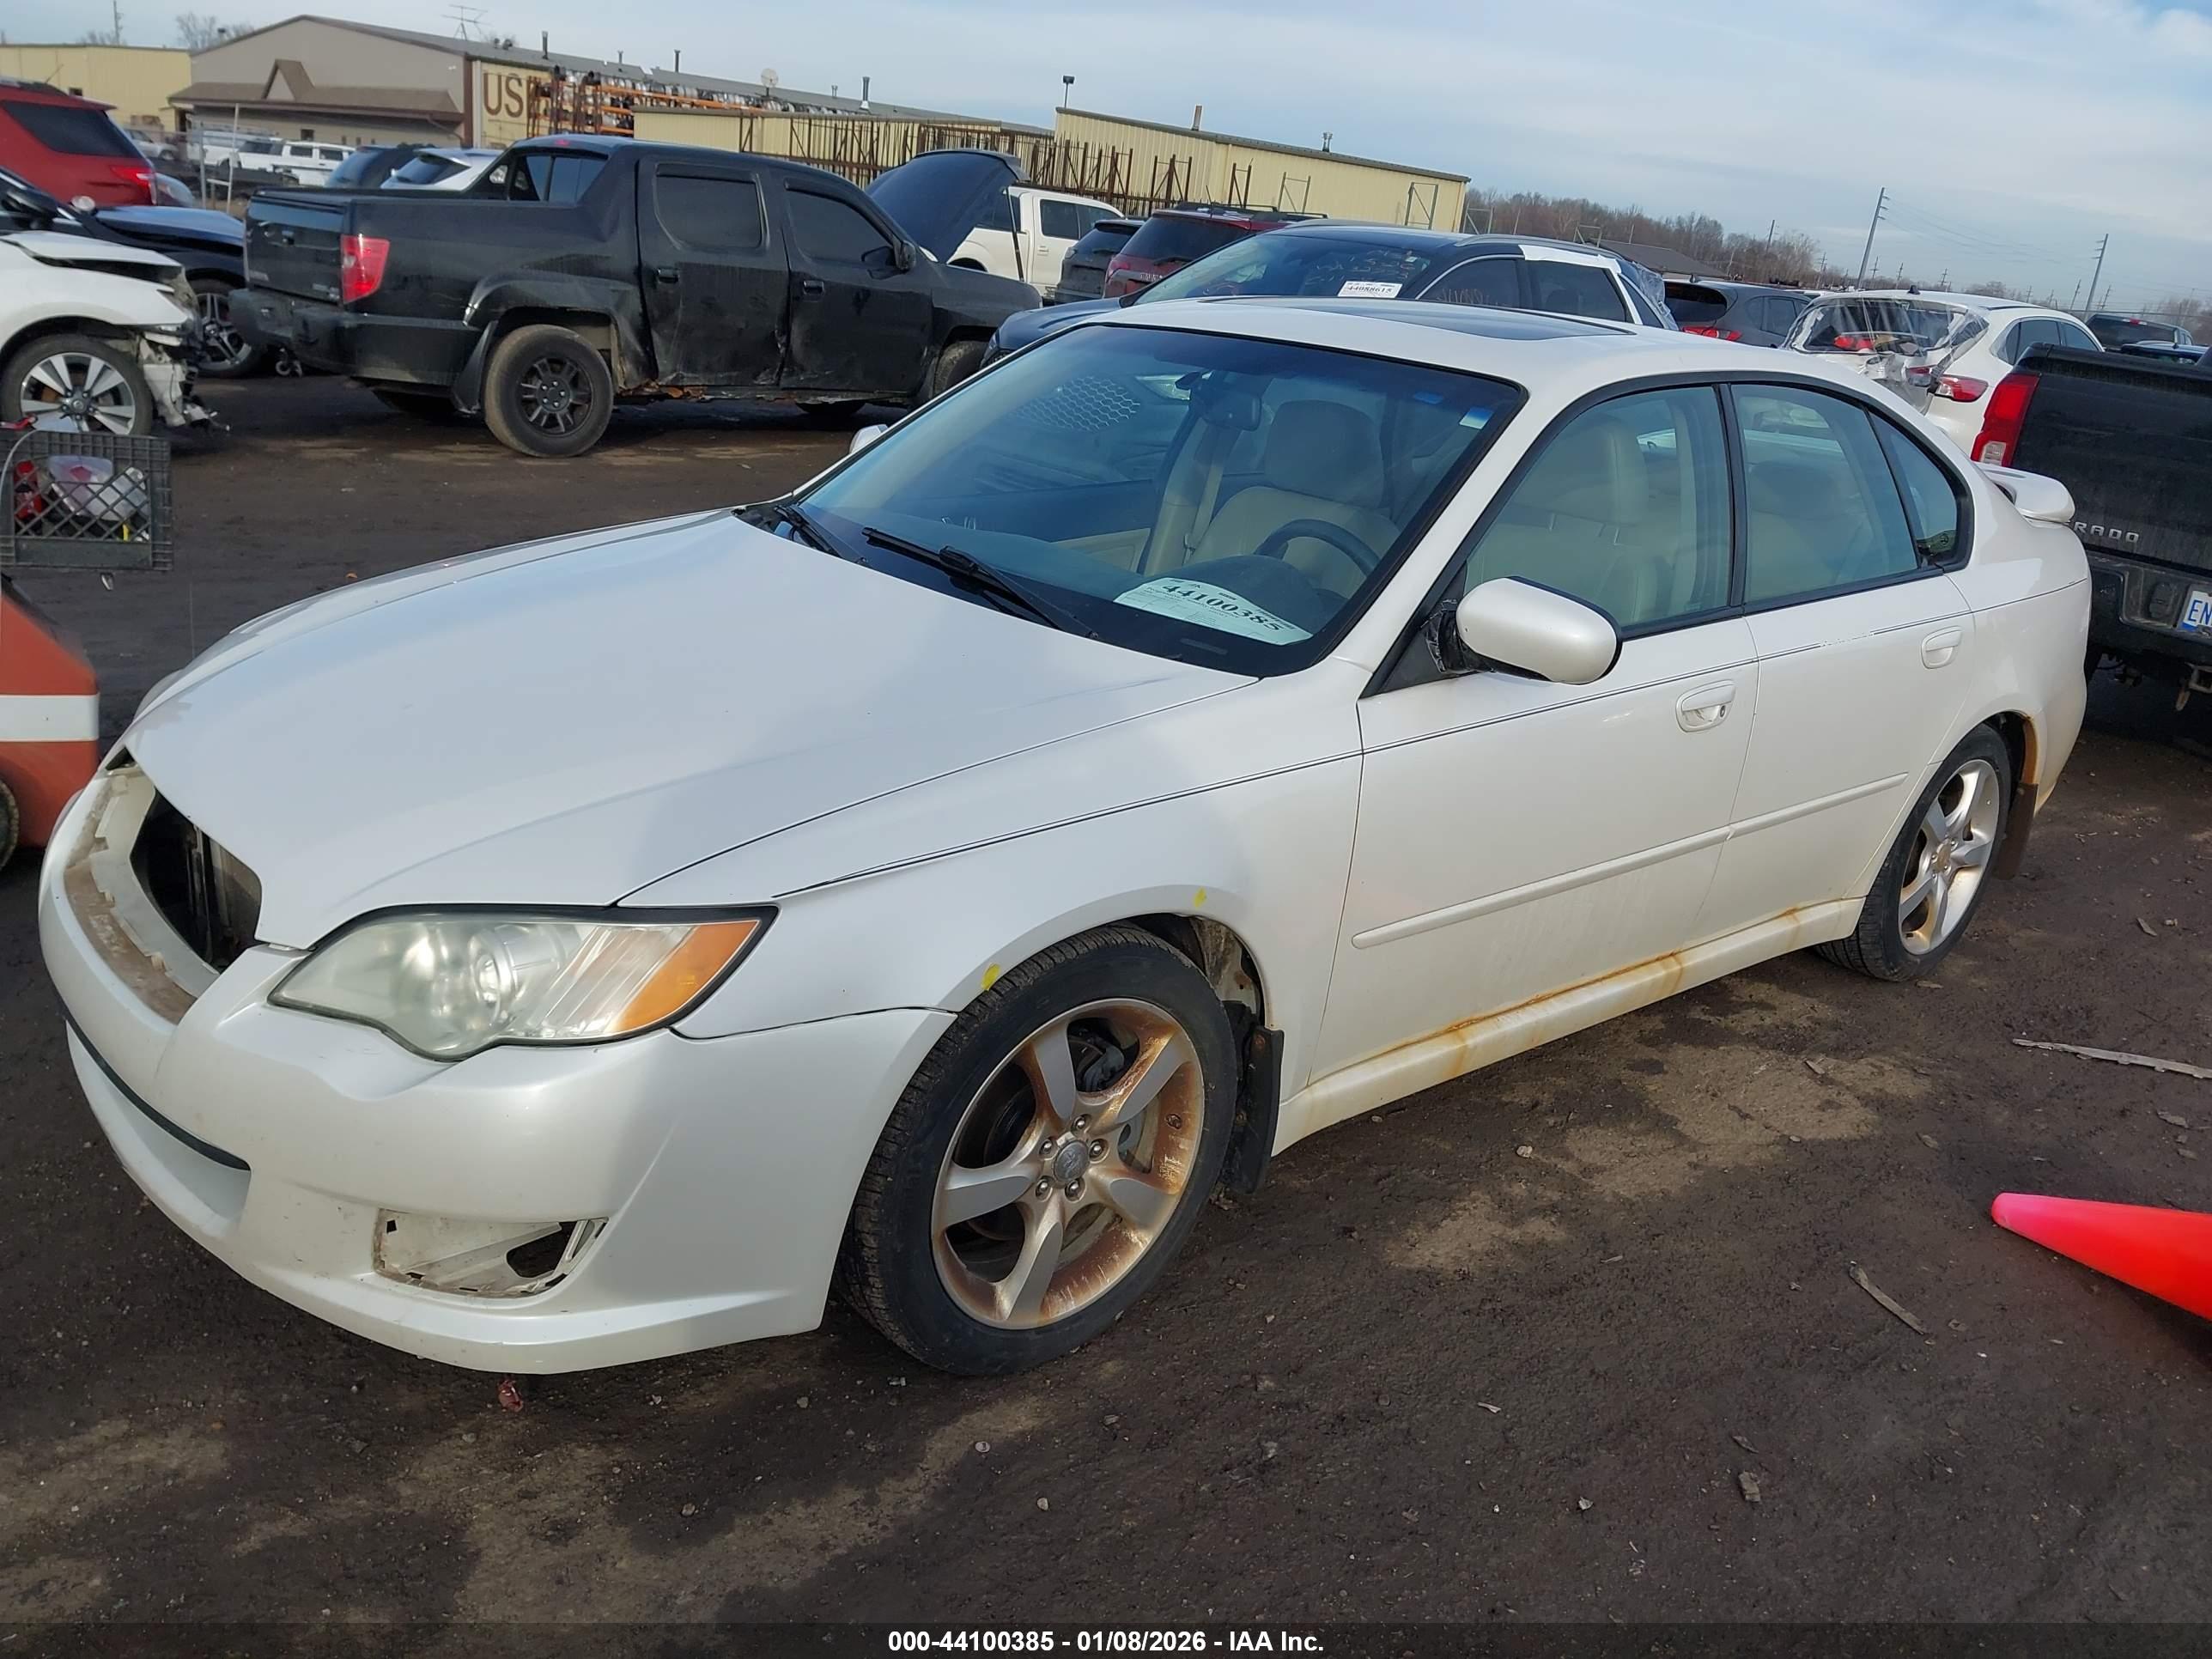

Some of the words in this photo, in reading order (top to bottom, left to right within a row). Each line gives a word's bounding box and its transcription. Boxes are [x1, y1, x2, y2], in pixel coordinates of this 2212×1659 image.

[483, 72, 530, 118] US
[2071, 520, 2140, 543] RADO
[1163, 584, 1285, 631] 44100385
